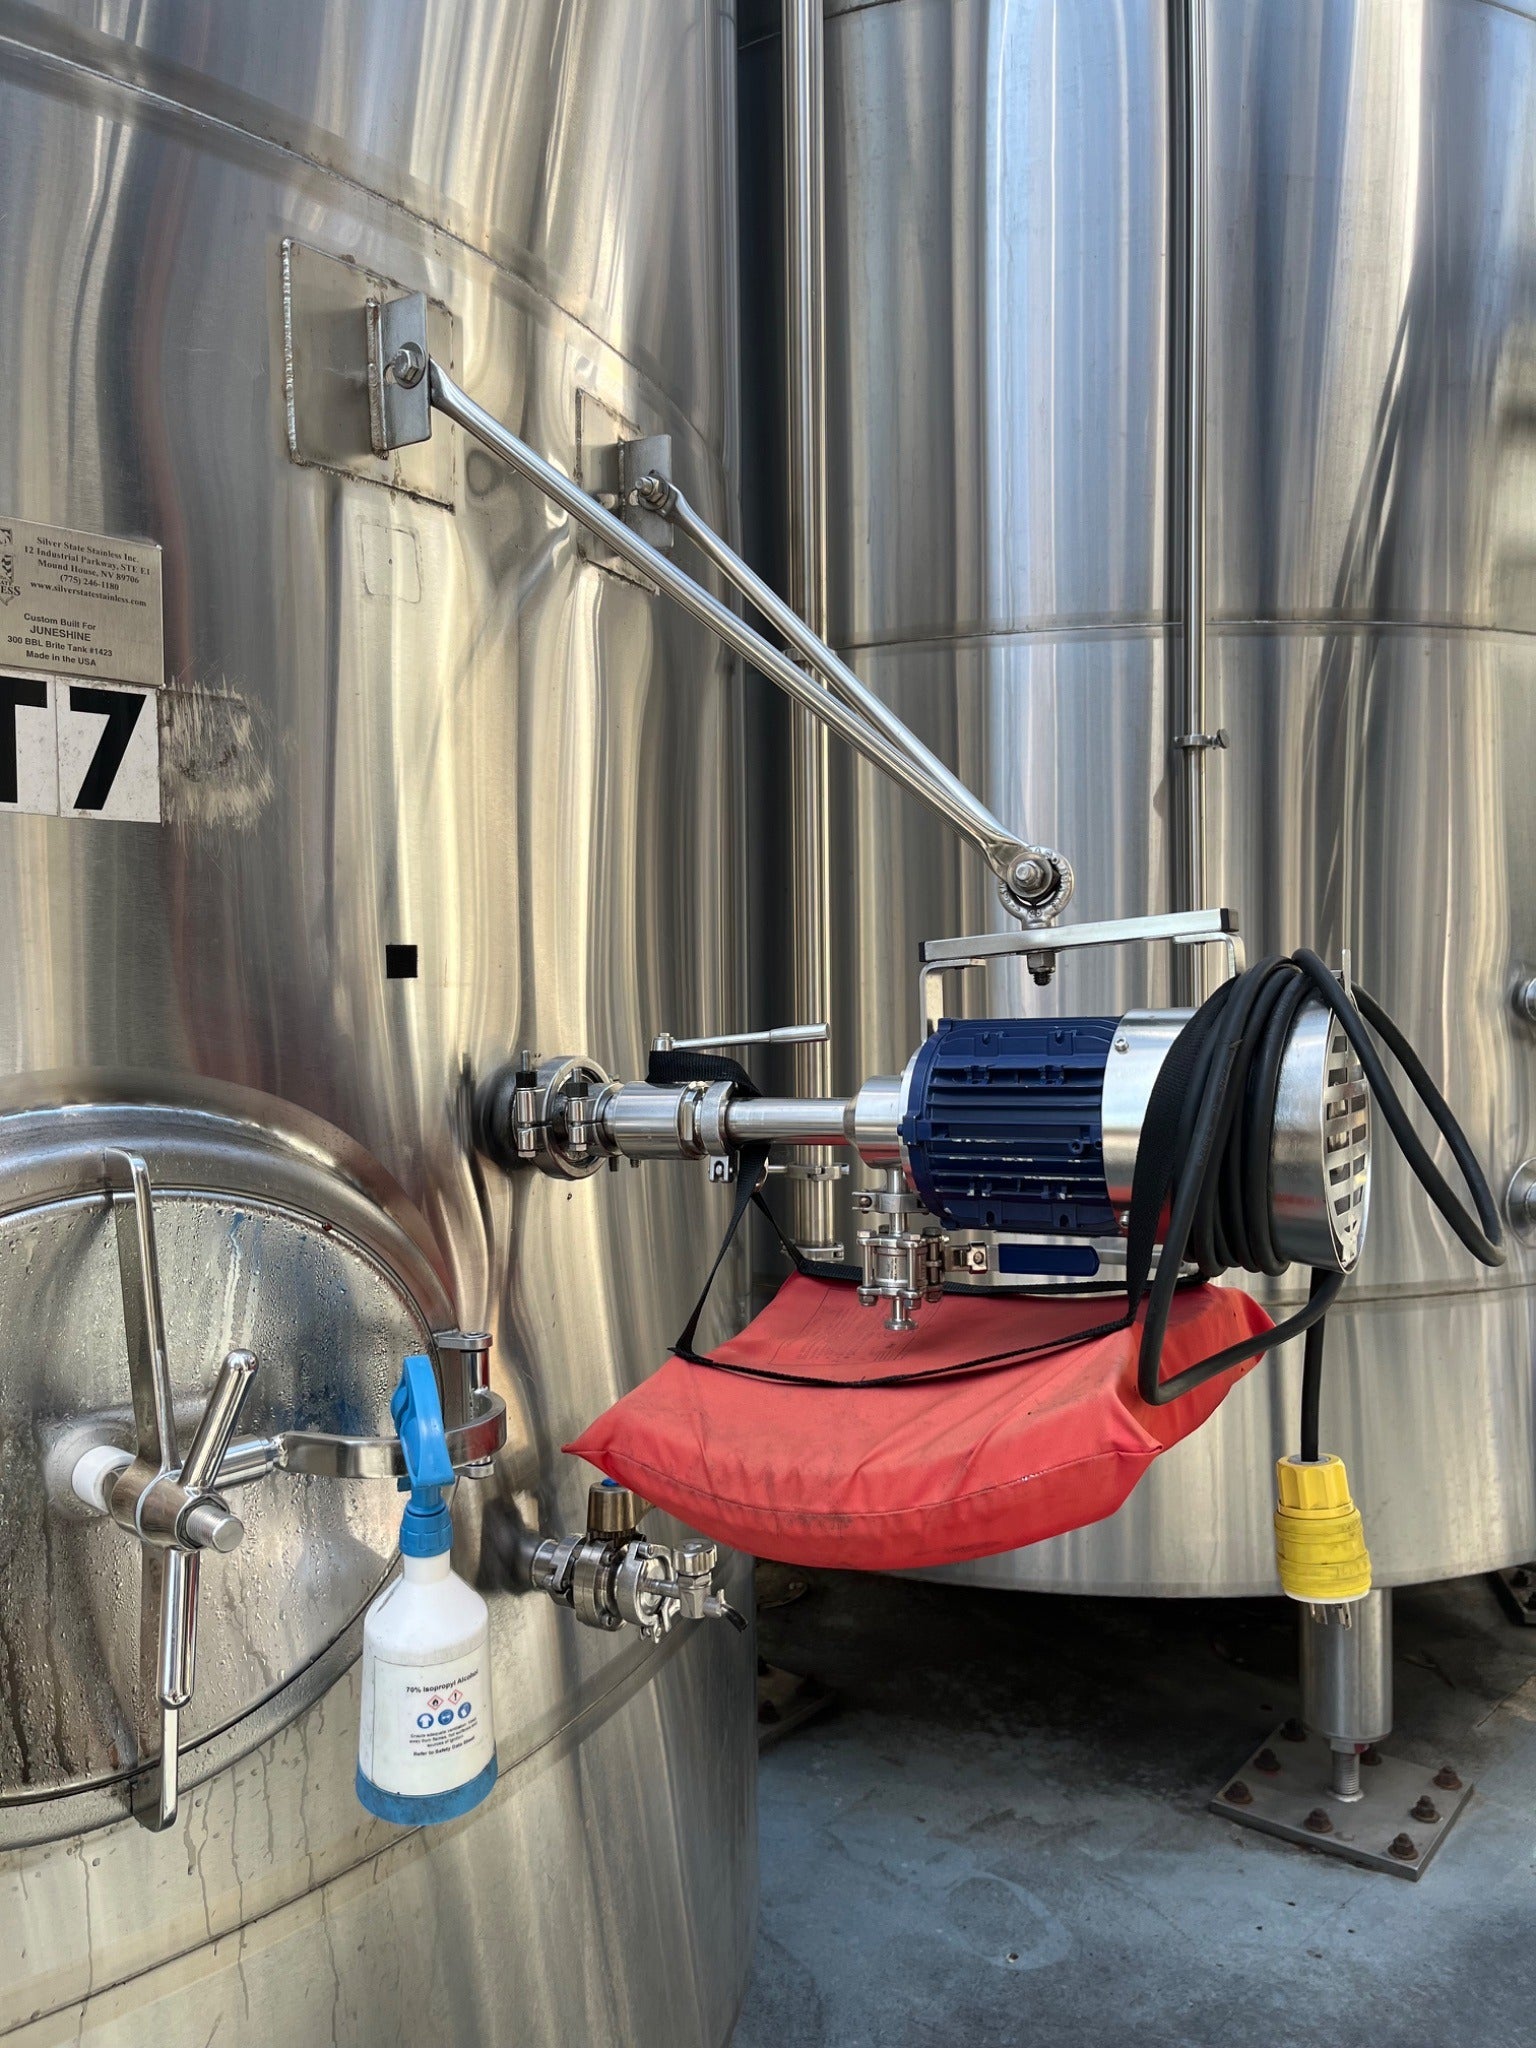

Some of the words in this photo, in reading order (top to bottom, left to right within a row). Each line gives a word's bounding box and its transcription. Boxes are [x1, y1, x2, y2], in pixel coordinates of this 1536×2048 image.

[24, 545, 34, 554] 12
[37, 547, 79, 562] Industrial
[81, 555, 120, 571] Parkway,
[120, 563, 138, 573] STE
[37, 537, 61, 548] Silver
[63, 541, 86, 552] State
[86, 545, 122, 560] Stainless
[124, 553, 140, 563] Inc.
[38, 558, 68, 571] Mound
[71, 564, 99, 577] House,
[101, 570, 114, 579] NV
[116, 573, 139, 584] 89706
[60, 574, 81, 586] (775)
[83, 578, 120, 591] 246-1180
[30, 581, 147, 607] www.silverstatestainless.com
[23, 612, 58, 625] Custom
[60, 618, 80, 629] Built
[82, 621, 97, 631] For
[29, 625, 92, 642] JUNESHINE
[7, 635, 23, 644] 300
[25, 637, 44, 647] BBL
[45, 640, 66, 650] Brite
[67, 643, 88, 653] Tank
[90, 647, 113, 657] #1423
[26, 650, 50, 660] Made
[52, 653, 60, 662] in
[62, 655, 76, 664] the
[78, 657, 97, 667] USA
[423, 1680, 456, 1692] Isopropyl
